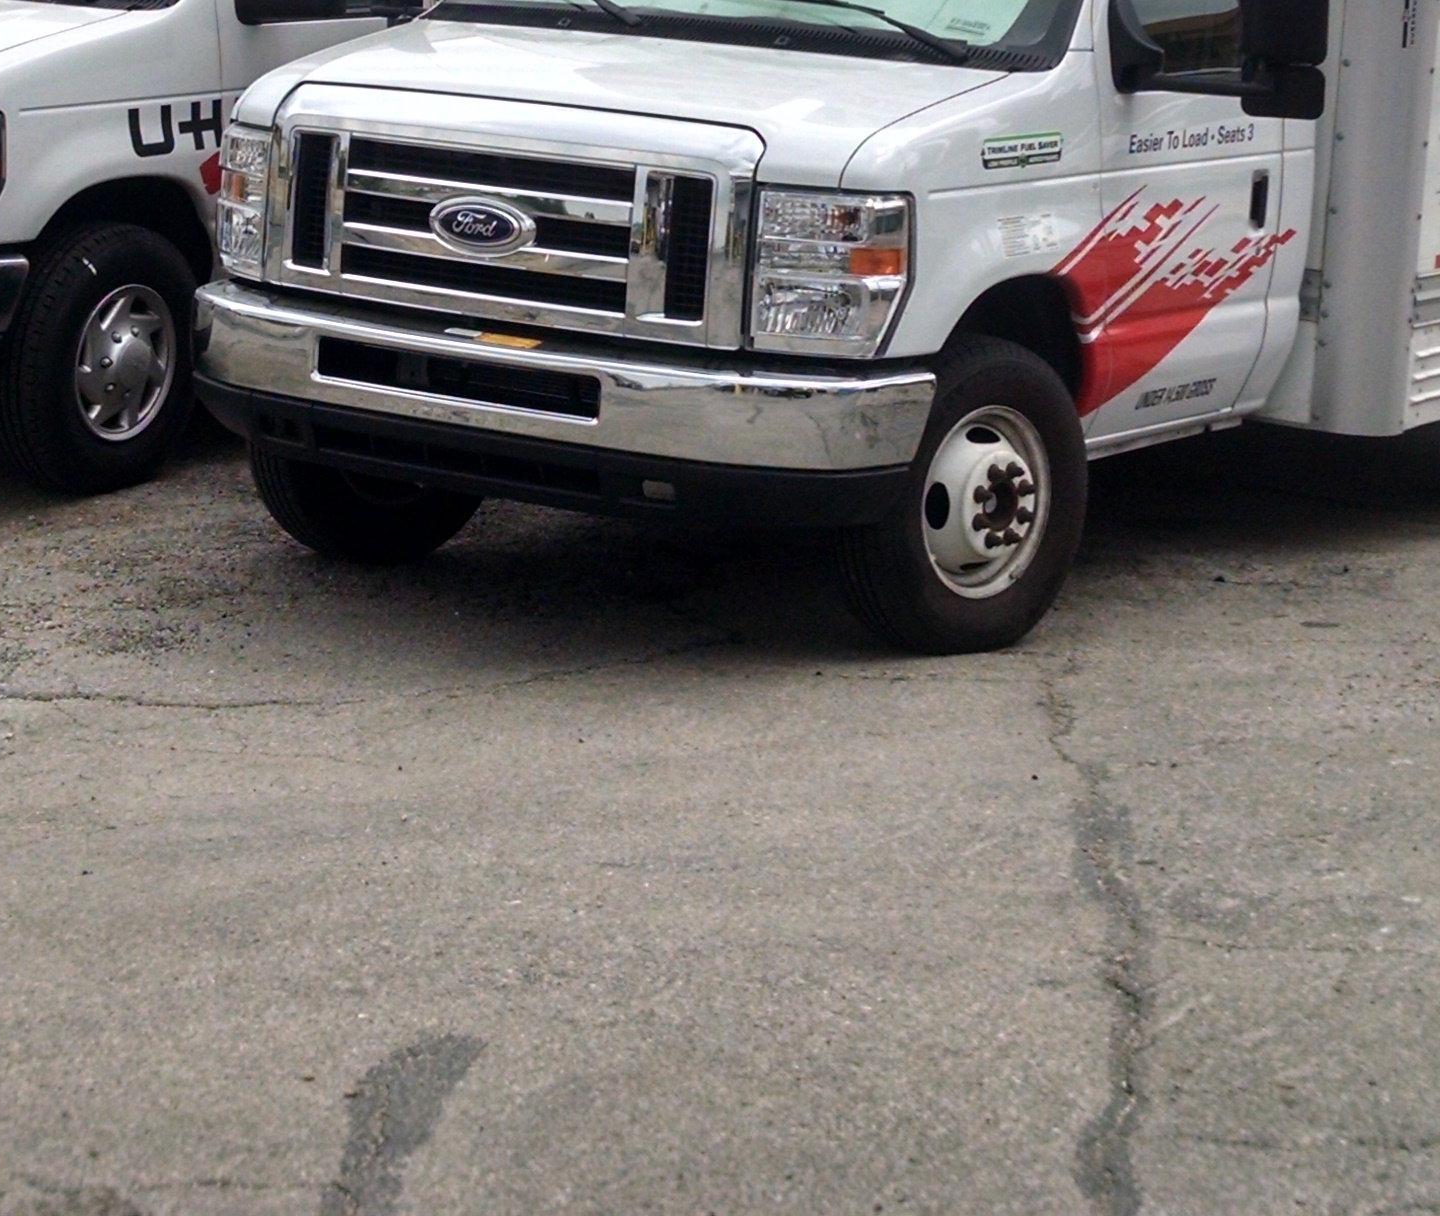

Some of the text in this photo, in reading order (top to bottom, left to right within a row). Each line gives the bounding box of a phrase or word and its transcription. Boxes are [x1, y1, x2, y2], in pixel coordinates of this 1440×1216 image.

[1020, 142, 1036, 152] FUEL
[1038, 140, 1059, 151] SAVER
[1129, 123, 1255, 154] Easier To Load Seats 3
[452, 210, 498, 237] Ford
